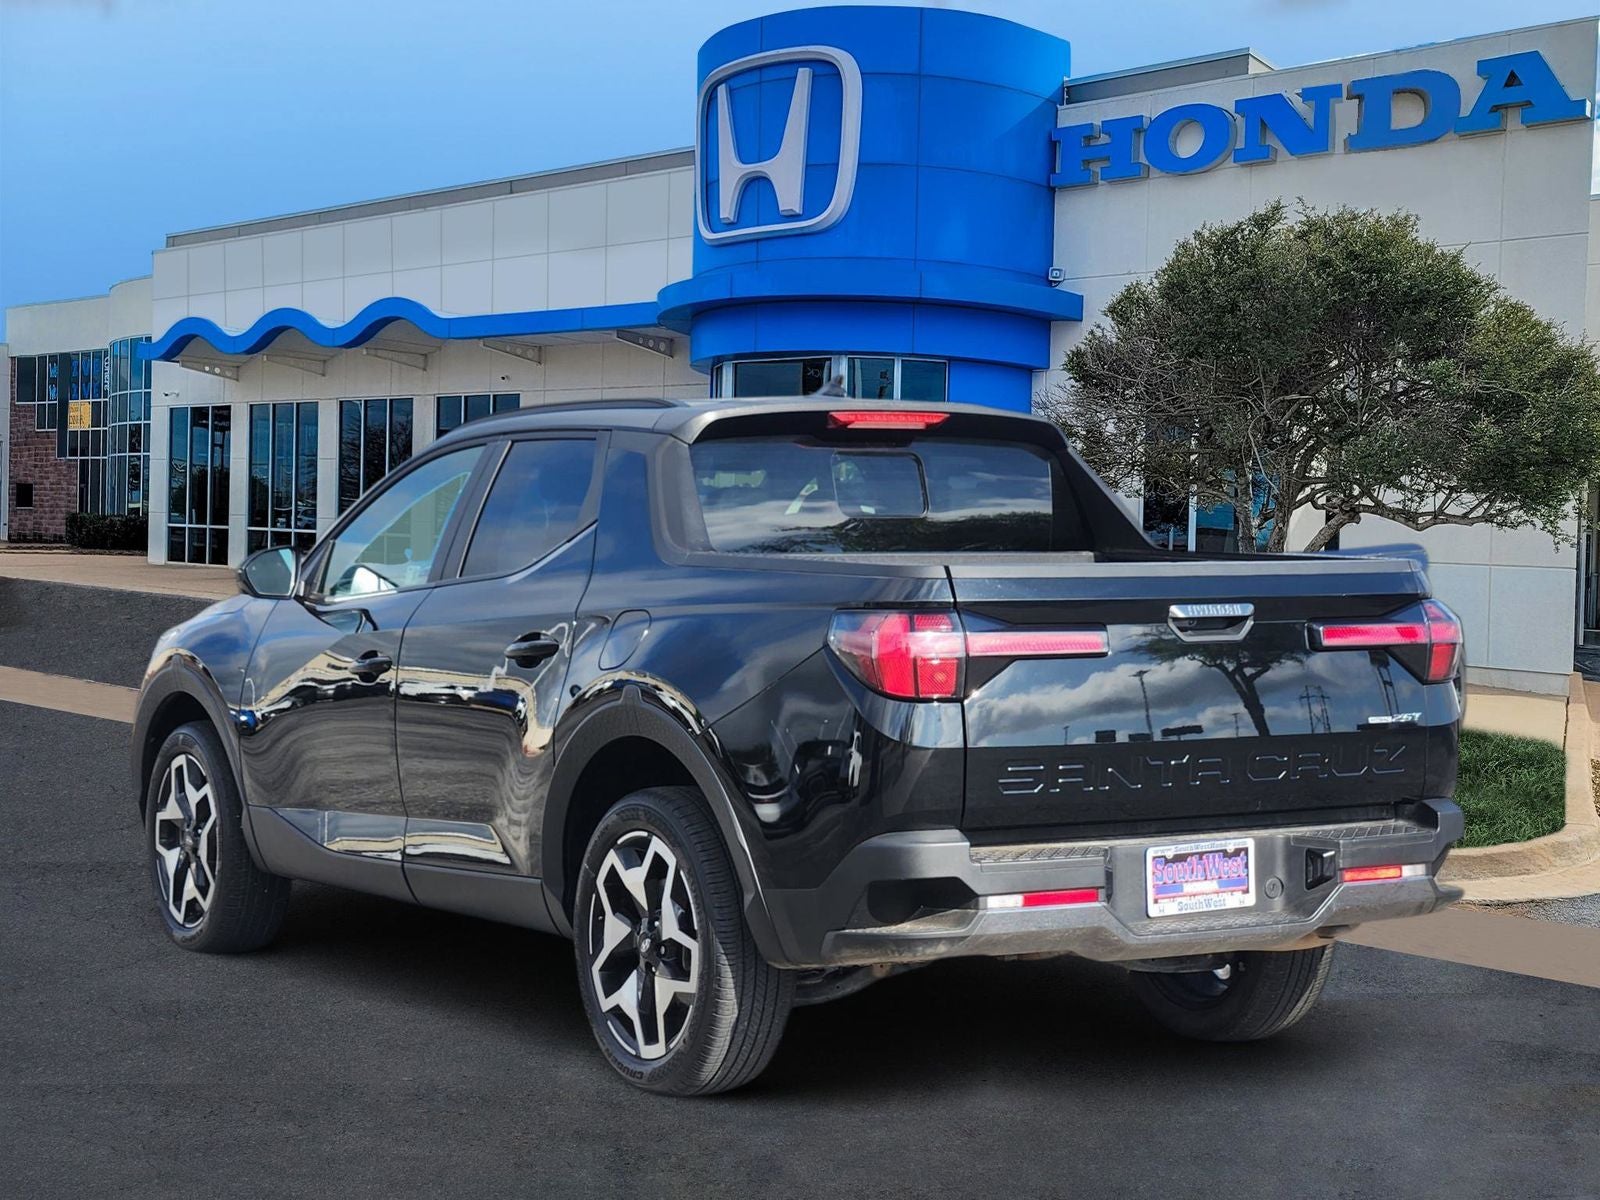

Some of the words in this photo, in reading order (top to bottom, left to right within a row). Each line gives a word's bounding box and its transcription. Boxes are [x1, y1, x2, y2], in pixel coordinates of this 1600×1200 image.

[1051, 50, 1591, 188] HONDA
[997, 753, 1231, 794] SANTA
[1247, 743, 1407, 782] CRUZ
